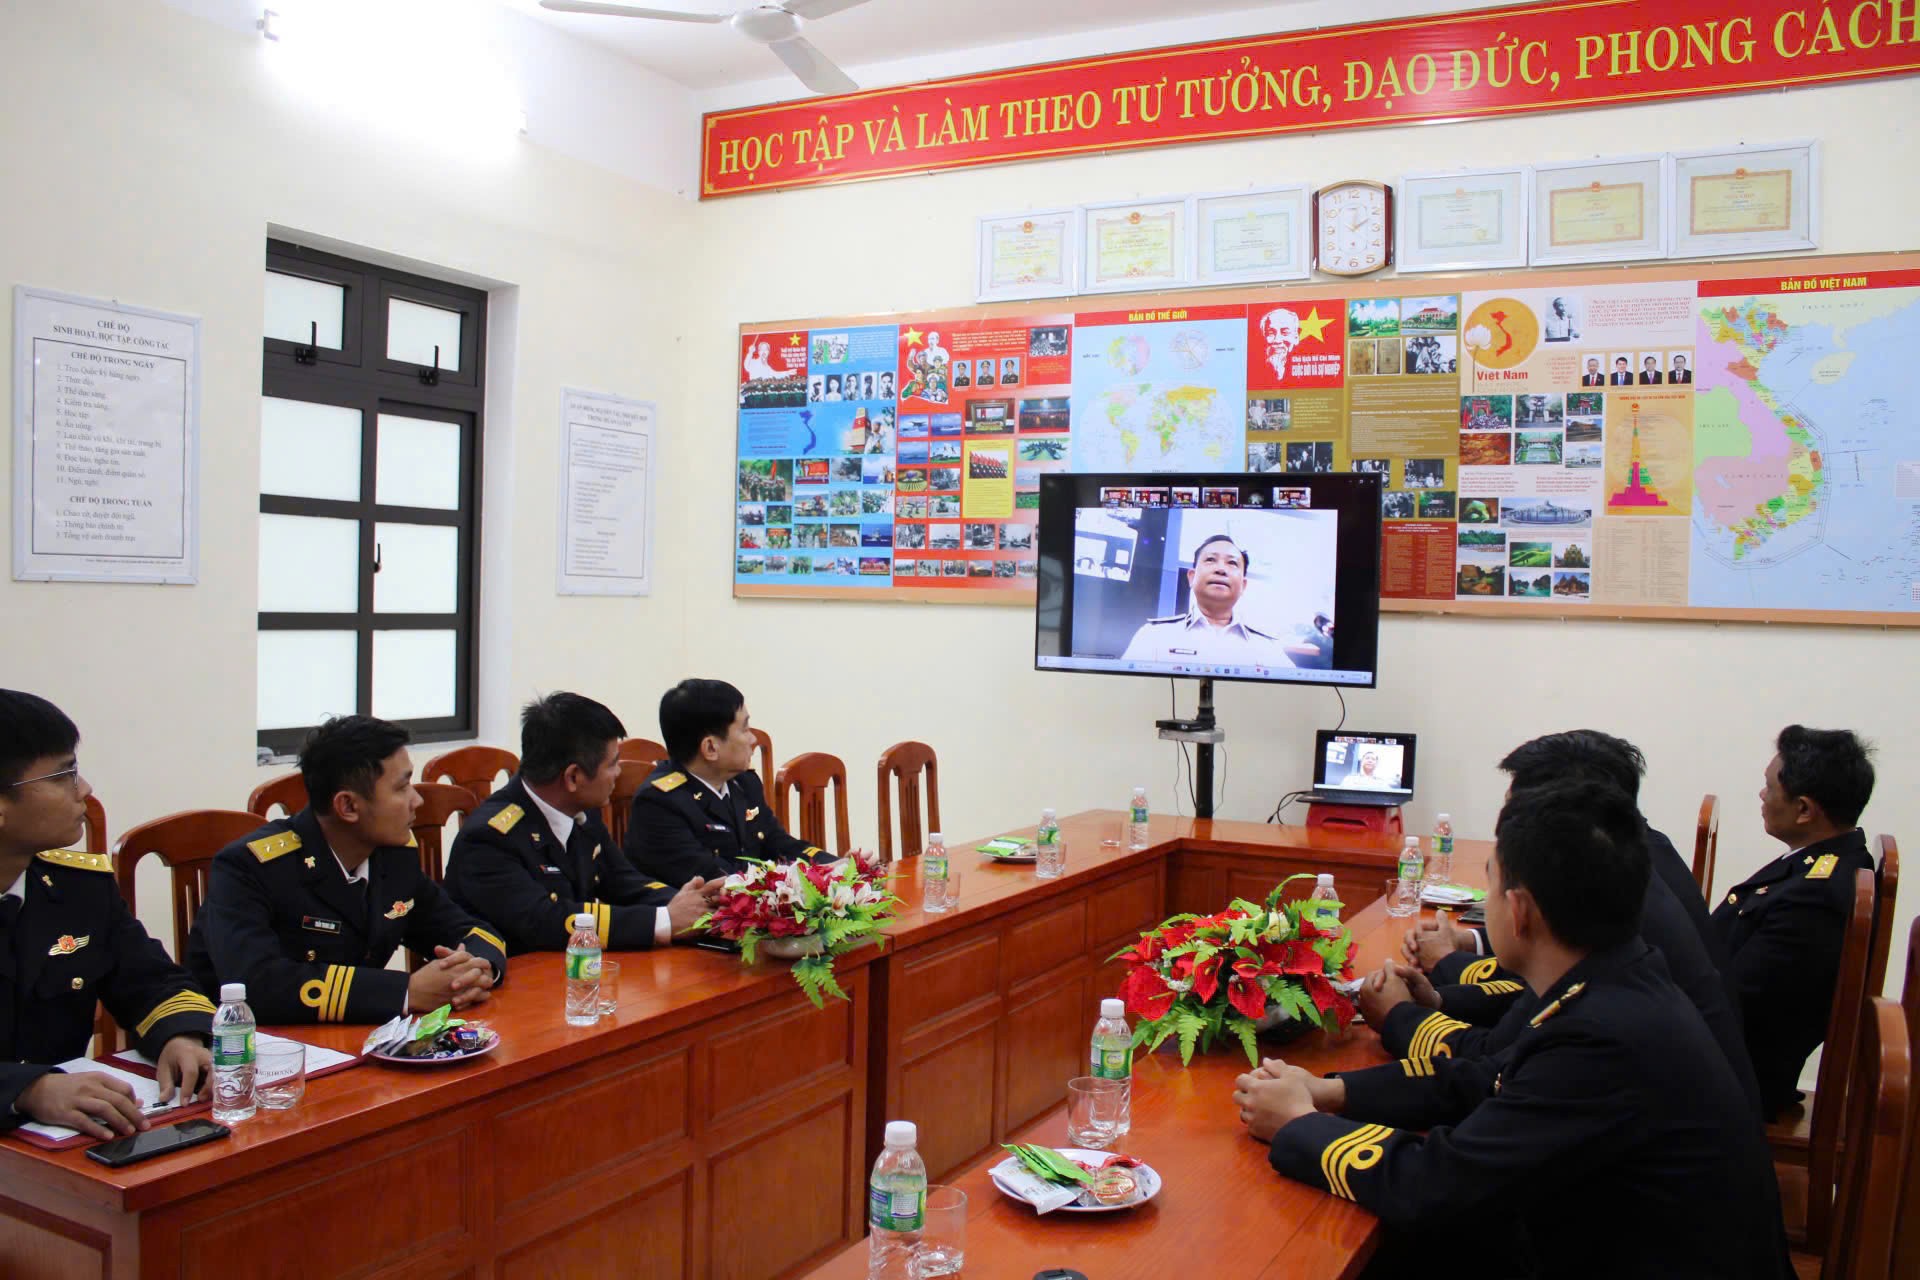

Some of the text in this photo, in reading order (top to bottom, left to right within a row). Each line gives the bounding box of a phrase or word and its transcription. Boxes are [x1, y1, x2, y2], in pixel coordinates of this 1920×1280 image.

[718, 0, 1920, 181] HỌC TẬP VÀ LÀM THEO TƯ TƯỞNG, ĐẠO ĐỨC, PHONG CÁCH
[1334, 194, 1342, 204] 11
[1345, 189, 1359, 199] 12
[1369, 191, 1375, 201] 1
[1372, 206, 1380, 216] 2
[1327, 226, 1336, 236] 9
[1372, 223, 1381, 233] 3
[1334, 256, 1343, 265] 7
[1349, 256, 1359, 268] 6
[1366, 254, 1376, 264] 5
[1780, 276, 1867, 291] BẢN ĐỒ VIỆT NAM
[1128, 308, 1188, 322] BẢN ĐỒ THẾ GIỚI
[97, 319, 130, 334] CHẾ ĐỘ
[53, 325, 73, 335] SINH
[133, 335, 155, 348] CÔNG
[71, 350, 155, 369] CHẾ ĐỘ TRONG NGÀY
[1503, 370, 1528, 380] Nam
